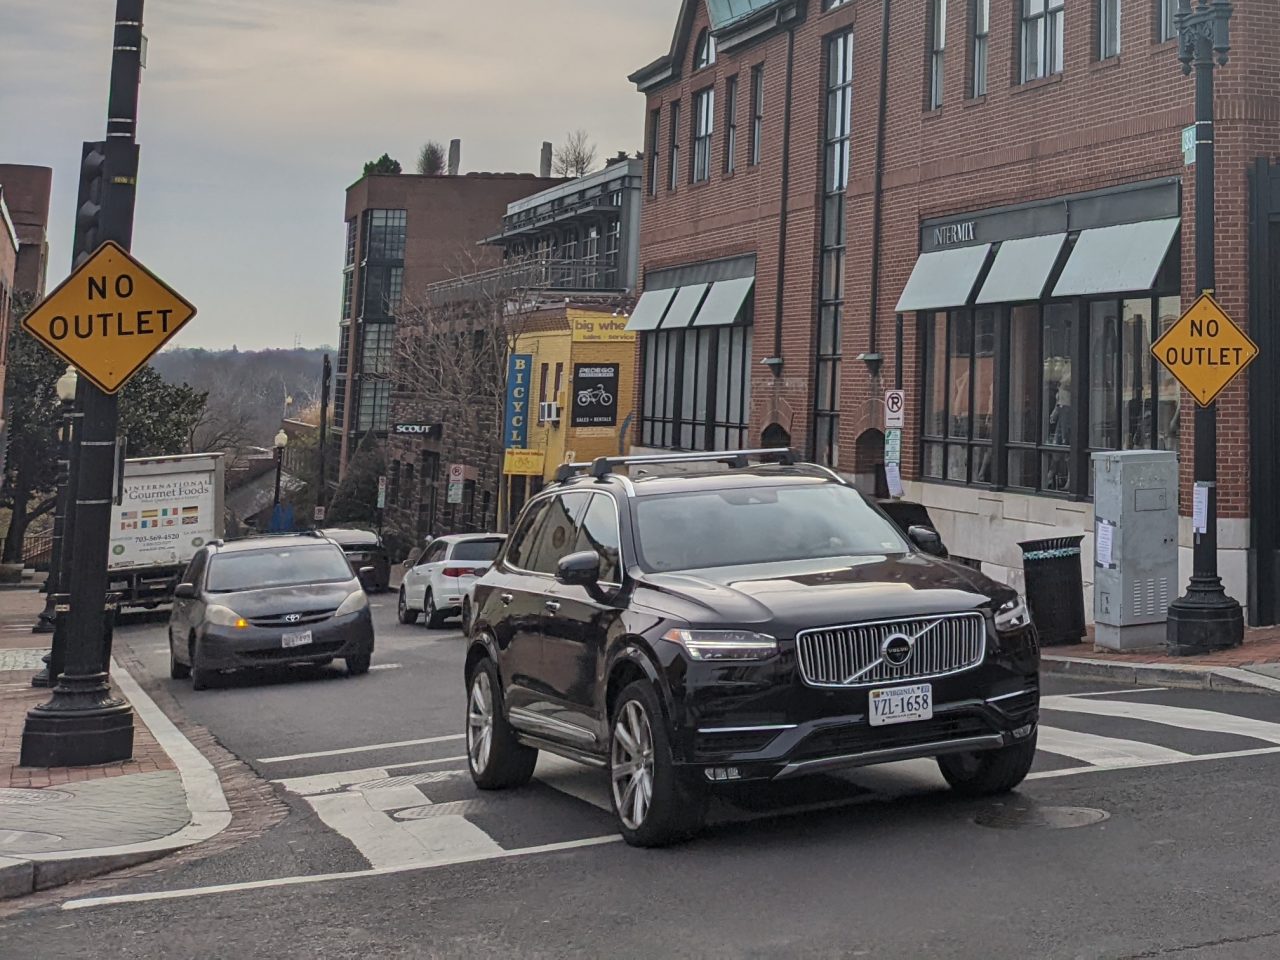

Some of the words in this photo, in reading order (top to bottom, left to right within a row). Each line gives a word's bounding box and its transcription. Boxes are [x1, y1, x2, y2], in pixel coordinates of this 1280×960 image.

[933, 221, 975, 246] INTERMIX
[87, 273, 134, 301] NO
[49, 309, 173, 341] OUTLET
[575, 320, 594, 332] big
[599, 320, 625, 330] whe
[1190, 319, 1219, 338] NO
[1166, 347, 1243, 366] OUTLET
[396, 425, 432, 433] SCOUT
[128, 480, 211, 492] INTERNATIONAL
[129, 487, 176, 500] Gourmet
[179, 484, 209, 496] Foods
[885, 688, 915, 697] VIRGINIA
[873, 693, 929, 717] VZL-1658
